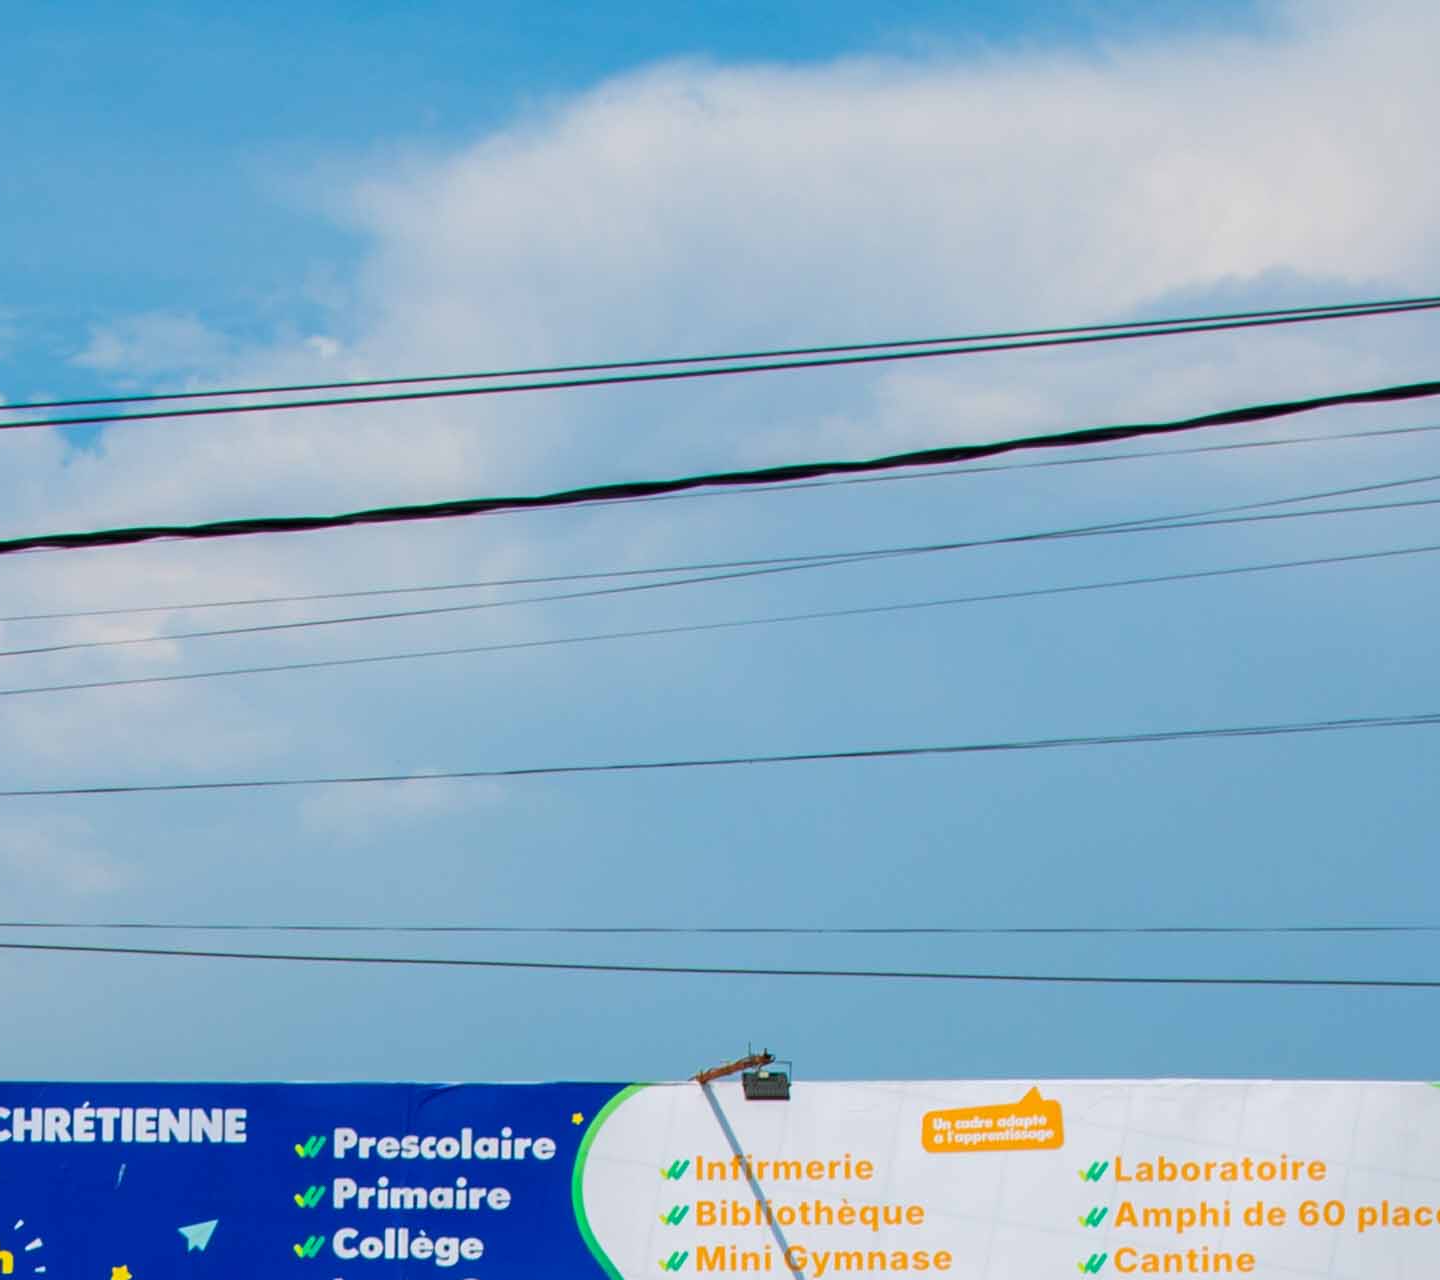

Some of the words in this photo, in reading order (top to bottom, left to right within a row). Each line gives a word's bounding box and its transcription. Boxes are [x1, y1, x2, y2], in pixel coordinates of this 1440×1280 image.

[933, 1118, 951, 1130] Un
[955, 1115, 993, 1128] cadre
[333, 1127, 556, 1160] Prescolaire
[695, 1154, 874, 1182] Infirmerie
[1114, 1155, 1328, 1182] Laboratoire
[333, 1178, 511, 1211] Primaire
[695, 1199, 925, 1232] Bibliothèque
[1114, 1200, 1231, 1233] Amphi
[1242, 1202, 1287, 1228] de
[1298, 1202, 1346, 1228] 60
[332, 1227, 484, 1266] Collège
[695, 1245, 773, 1273] Mini
[784, 1245, 953, 1280] Gymnase
[1114, 1247, 1257, 1274] Cantine
